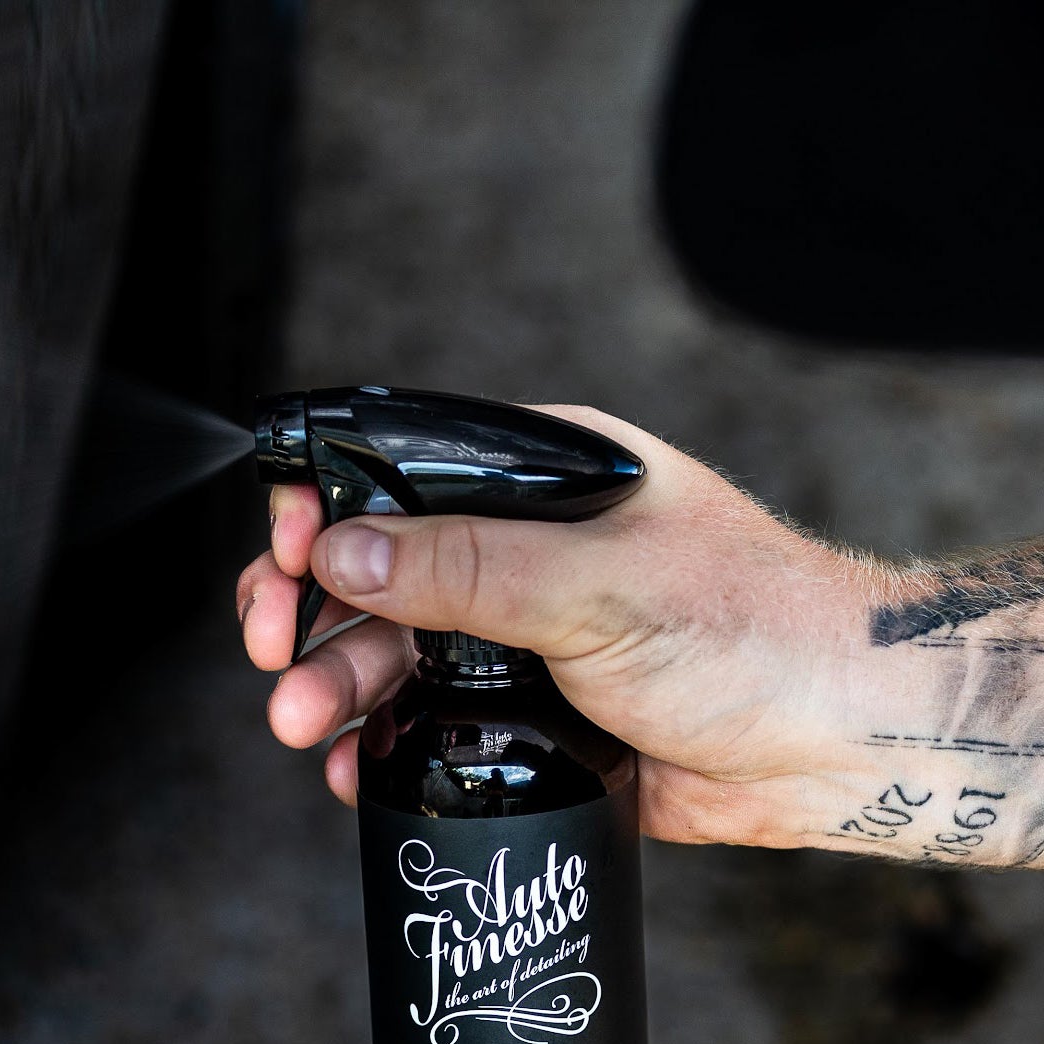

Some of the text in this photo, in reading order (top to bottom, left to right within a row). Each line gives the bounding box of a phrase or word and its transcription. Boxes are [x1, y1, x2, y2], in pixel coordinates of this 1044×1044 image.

[450, 843, 587, 942] Auto
[403, 885, 589, 1027] Finesse
[444, 933, 591, 1009] the art of detailing
